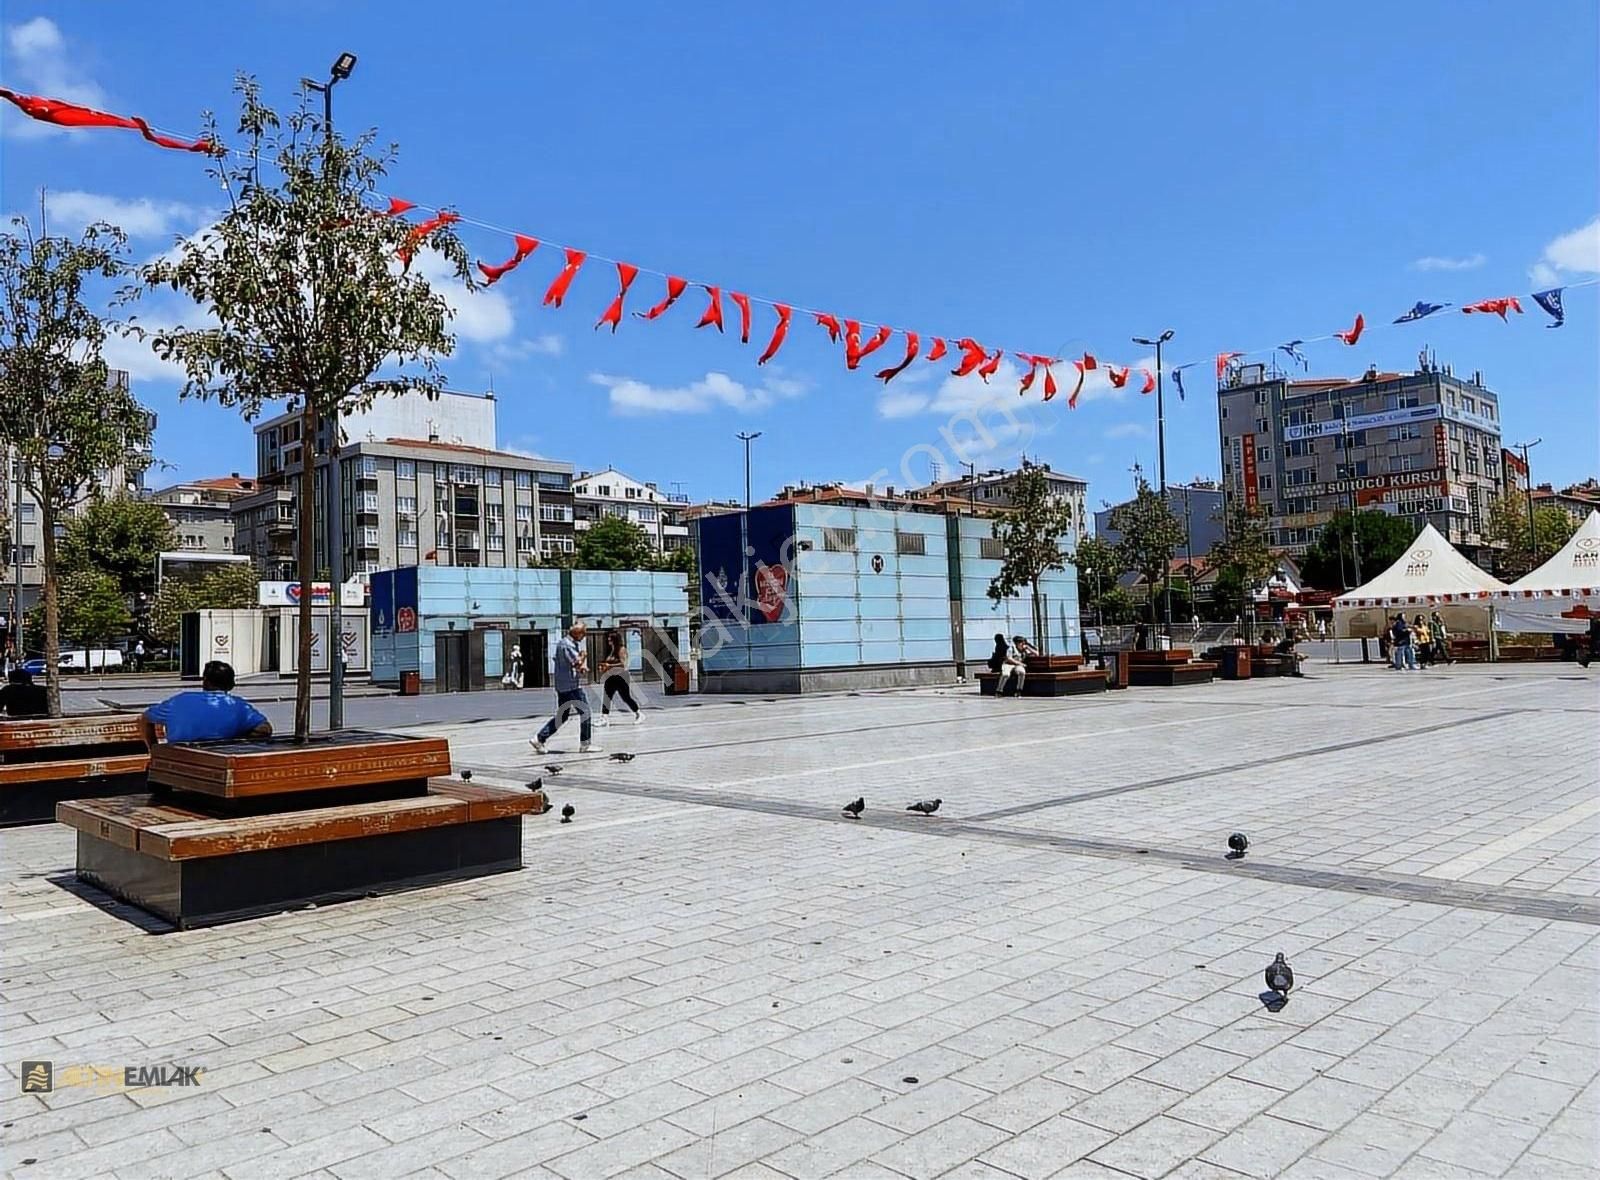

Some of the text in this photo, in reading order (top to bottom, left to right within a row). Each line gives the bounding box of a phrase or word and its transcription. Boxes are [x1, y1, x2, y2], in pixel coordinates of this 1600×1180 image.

[1328, 474, 1385, 494] SÜRÜCÜ
[1390, 470, 1441, 487] KURSU
[1398, 498, 1442, 514] KURSU
